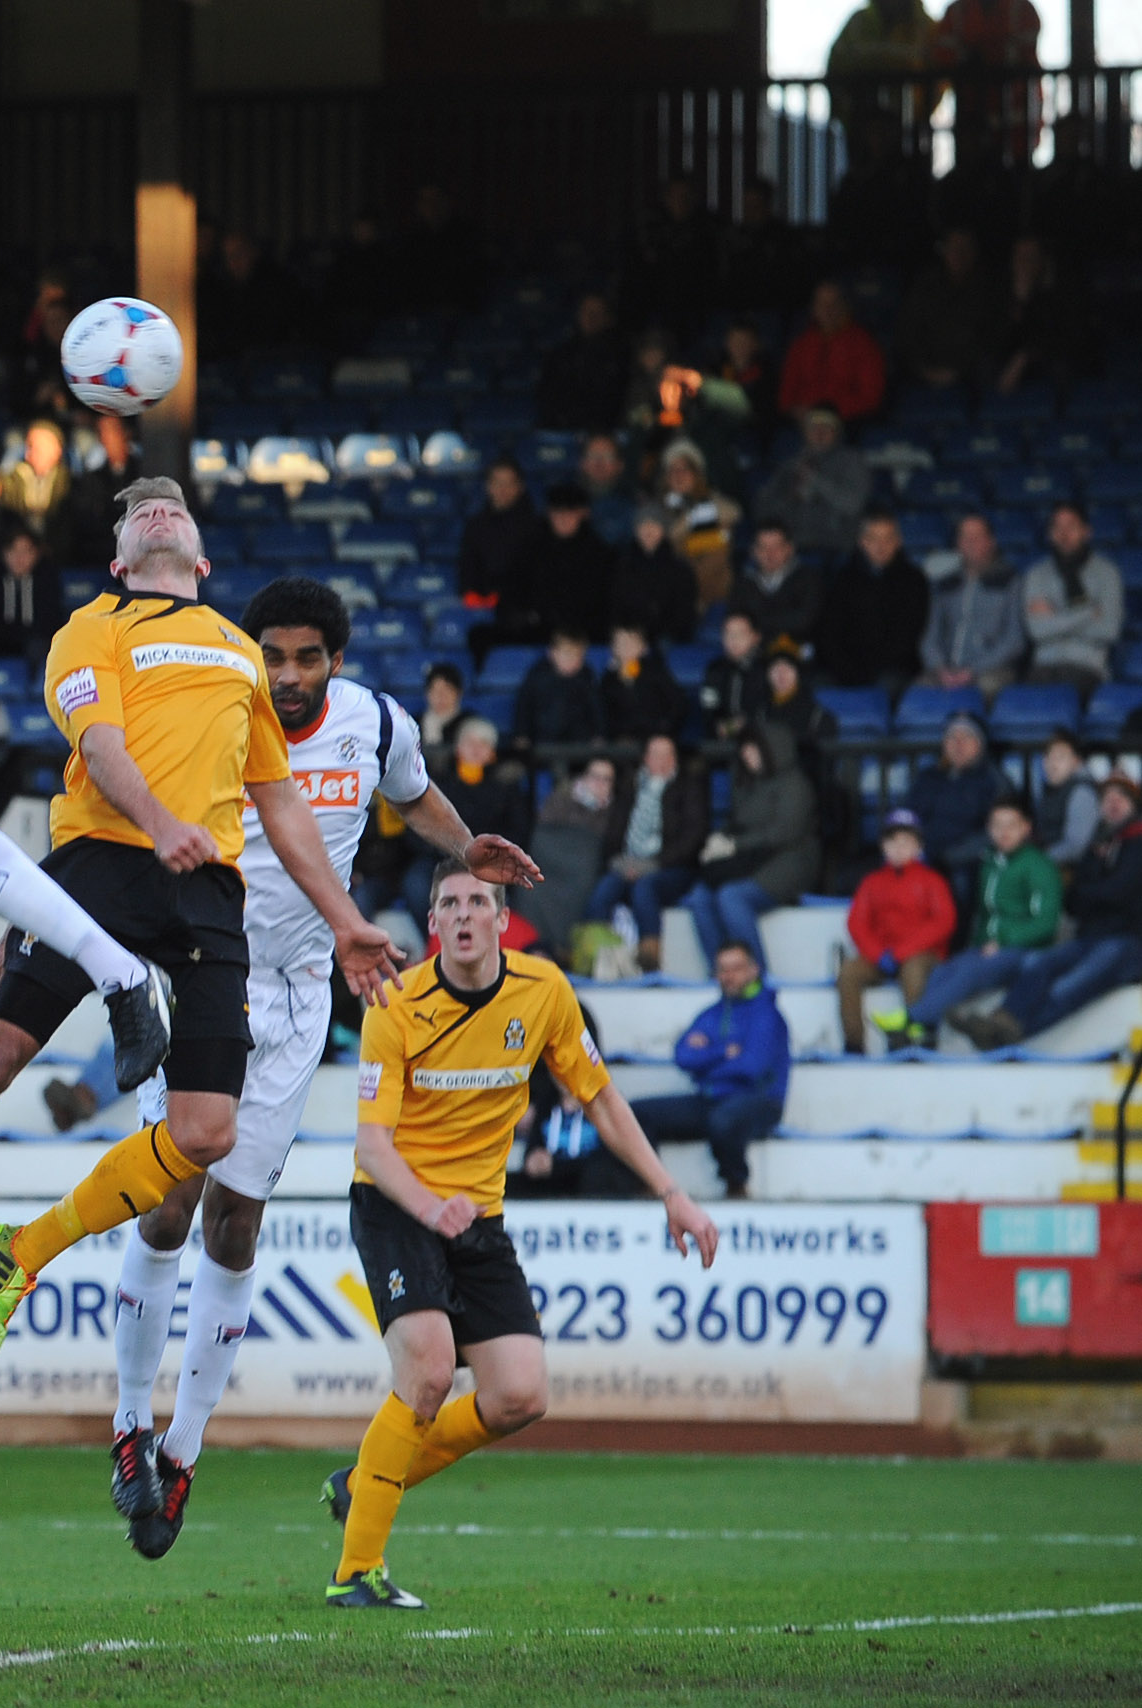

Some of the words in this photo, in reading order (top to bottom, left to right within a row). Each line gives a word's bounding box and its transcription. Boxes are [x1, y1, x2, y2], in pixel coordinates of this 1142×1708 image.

[135, 648, 172, 669] MICK
[414, 1073, 444, 1087] MICK
[446, 1073, 494, 1088] GEORGE
[1020, 1274, 1067, 1318] 14
[655, 1283, 890, 1345] 360999
